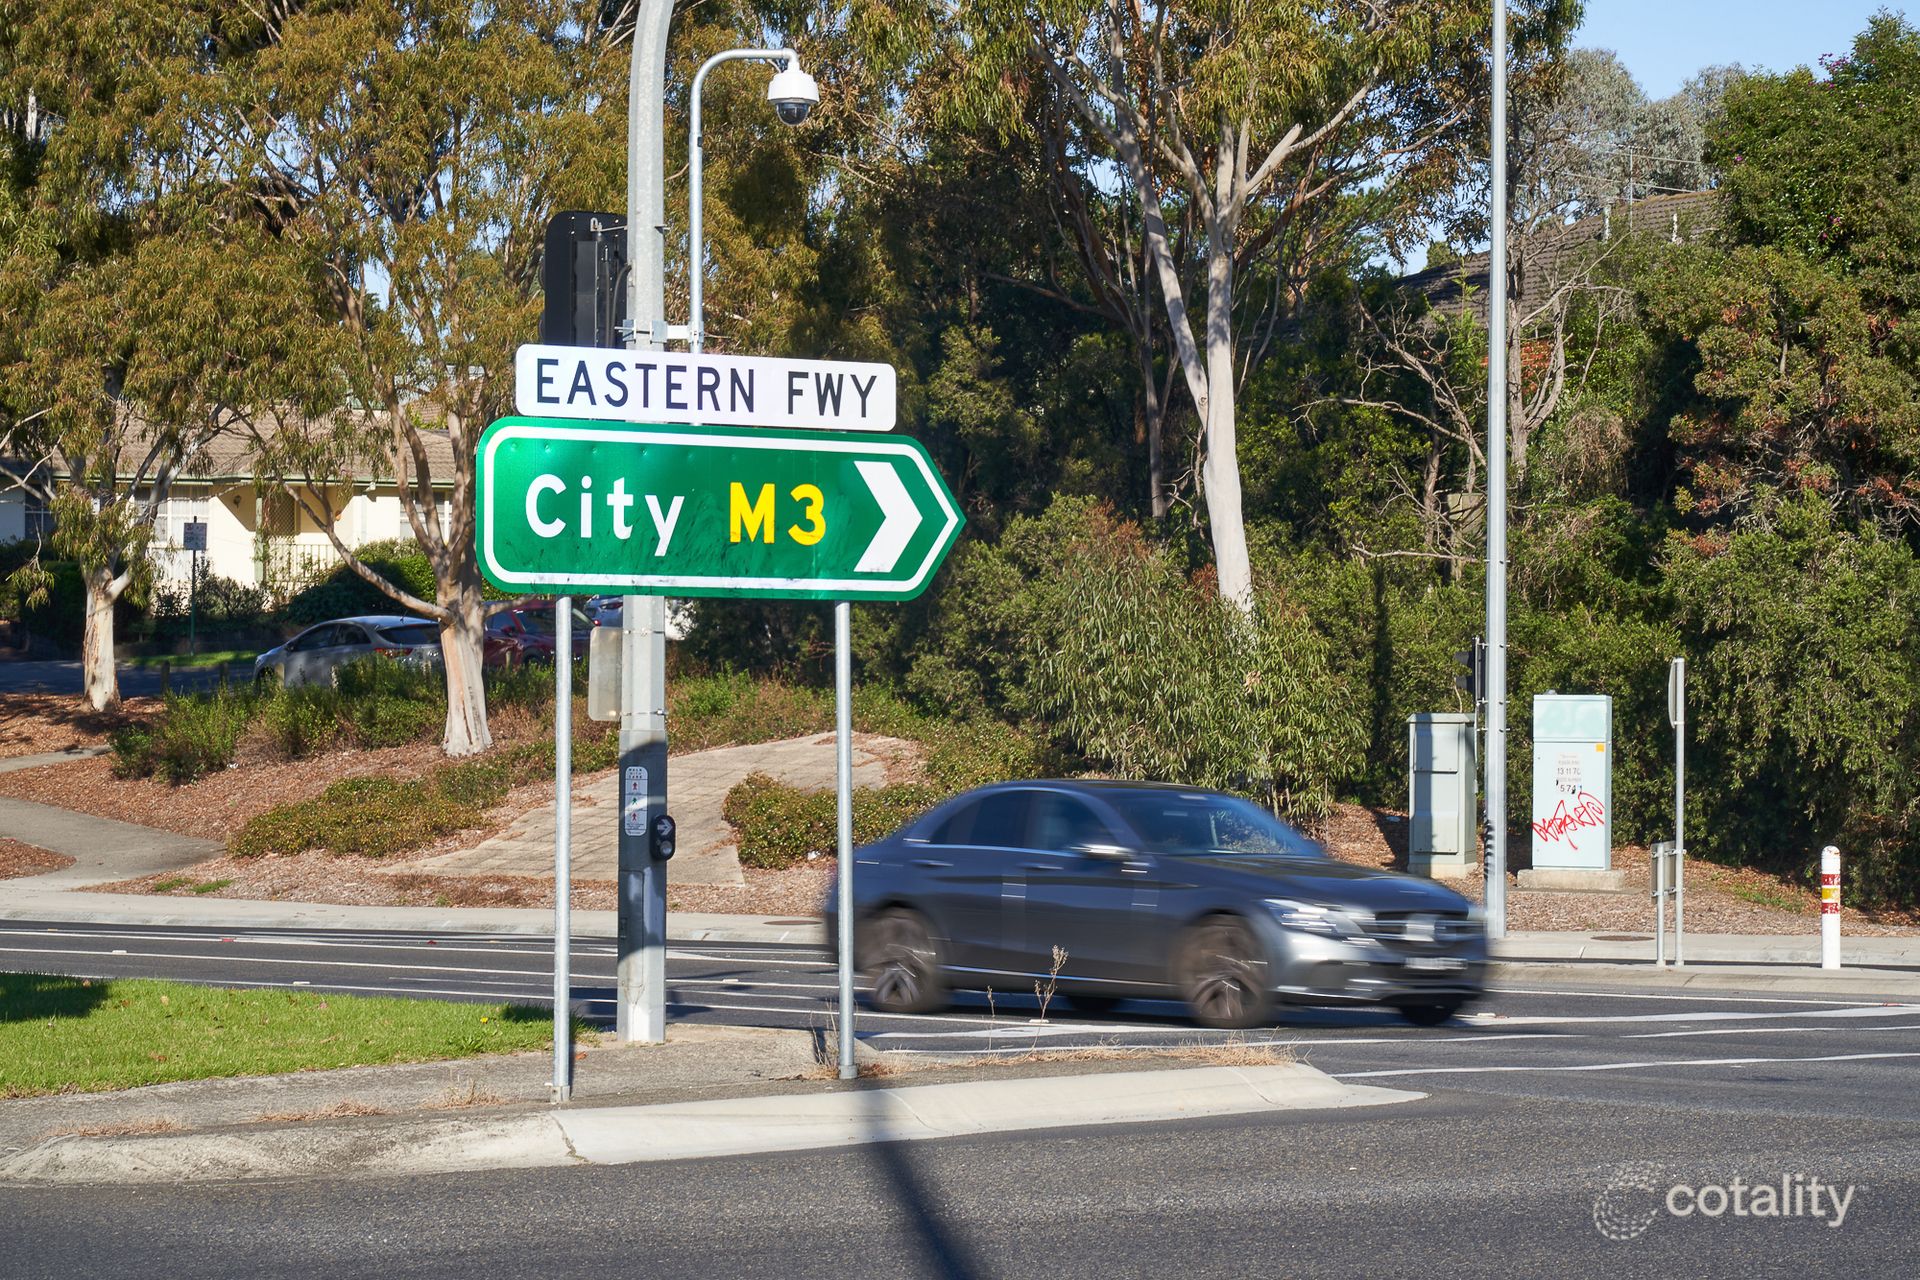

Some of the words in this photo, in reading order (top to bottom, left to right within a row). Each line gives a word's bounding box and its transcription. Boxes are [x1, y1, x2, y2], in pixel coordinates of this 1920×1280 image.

[536, 358, 754, 413] EASTERN
[788, 371, 878, 419] FWY
[525, 473, 685, 557] City
[729, 481, 826, 547] M3
